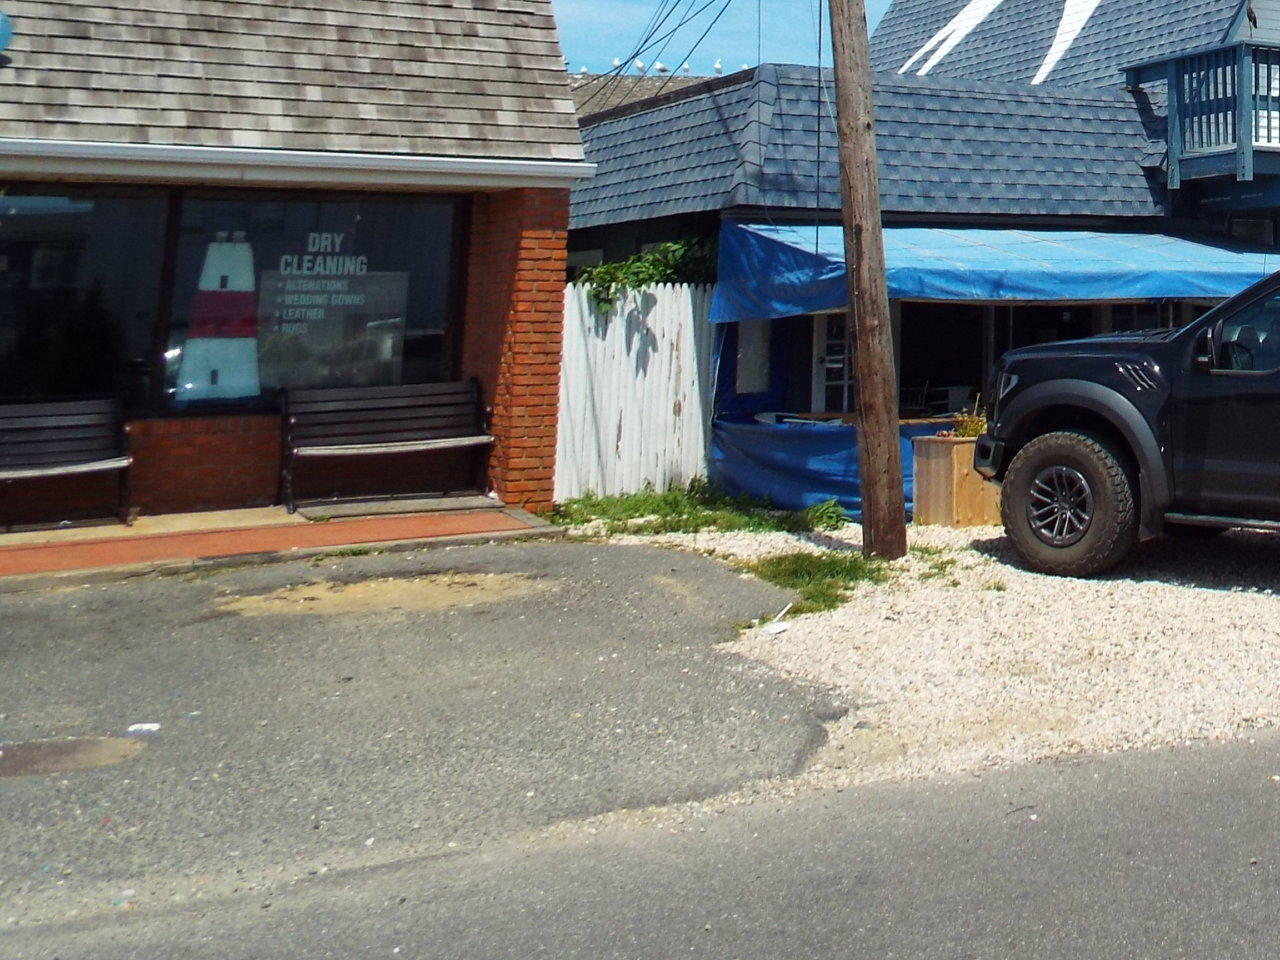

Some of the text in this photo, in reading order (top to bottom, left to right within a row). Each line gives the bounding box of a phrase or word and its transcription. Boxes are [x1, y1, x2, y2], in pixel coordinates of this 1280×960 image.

[307, 232, 345, 252] DRY
[279, 254, 368, 276] CLEANING
[284, 279, 349, 291] ALTERATIONS
[284, 294, 366, 305] WEDDING GOWNS
[282, 308, 325, 320] LEATHER
